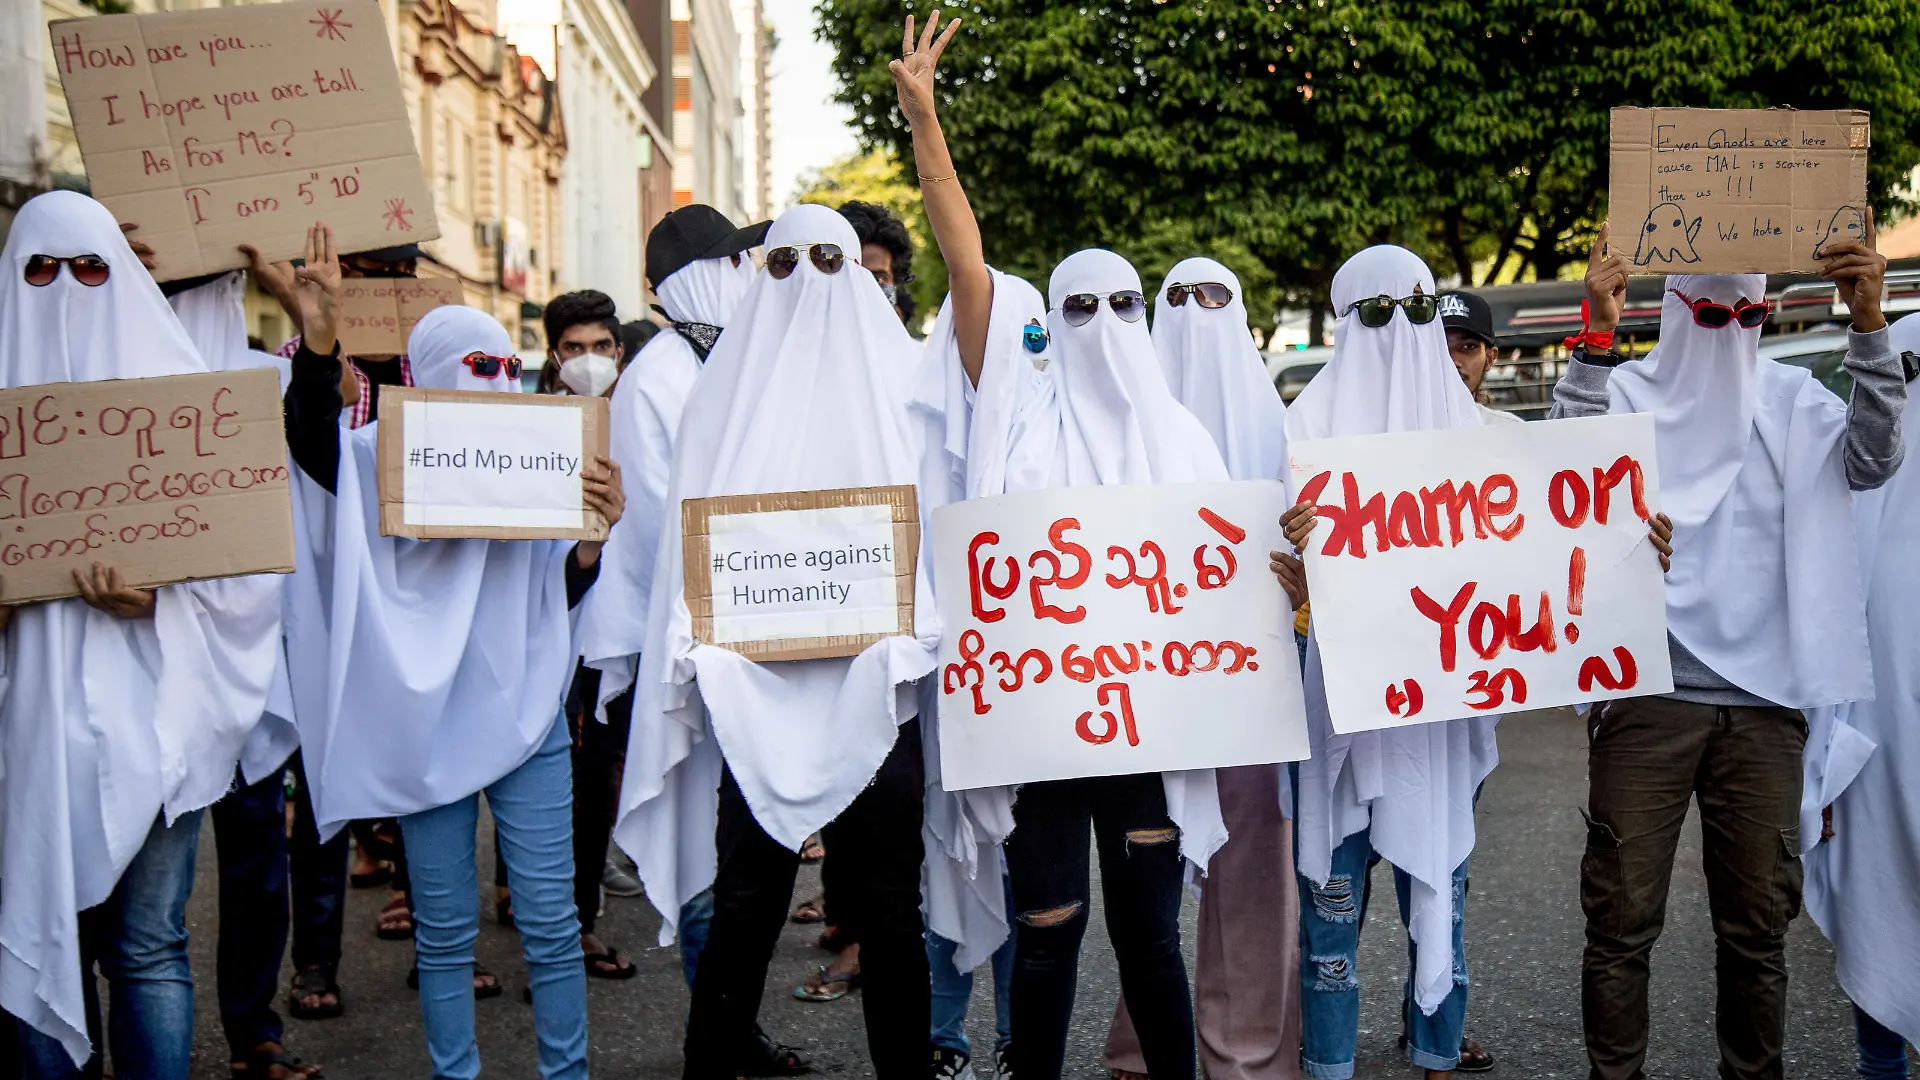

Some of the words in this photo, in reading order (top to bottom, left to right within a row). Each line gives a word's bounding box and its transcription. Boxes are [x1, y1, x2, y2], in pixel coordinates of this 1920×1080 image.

[62, 34, 135, 74] How
[147, 43, 187, 64] are
[106, 95, 126, 127] I
[141, 90, 205, 126] hope
[215, 90, 260, 121] you
[270, 82, 308, 99] are
[1656, 124, 1699, 153] Even
[1764, 138, 1789, 148] are
[1802, 131, 1826, 147] here
[142, 150, 171, 176] As
[1657, 163, 1694, 174] cause
[1706, 154, 1741, 173] MAL
[1752, 160, 1764, 170] is
[1775, 158, 1821, 170] scarier
[185, 188, 212, 225] I
[237, 197, 279, 218] am
[1658, 184, 1686, 202] than
[1696, 189, 1712, 198] us
[1717, 221, 1740, 242] We
[1752, 217, 1783, 237] hate
[1795, 225, 1805, 234] u
[409, 447, 467, 468] #End
[475, 450, 512, 474] Mp
[520, 451, 578, 477] unity
[1295, 471, 1525, 559] Shame
[1548, 455, 1650, 529] on
[712, 550, 798, 573] #Crime
[804, 543, 892, 571] against
[733, 580, 851, 606] Humanity
[1410, 546, 1587, 673] You!
